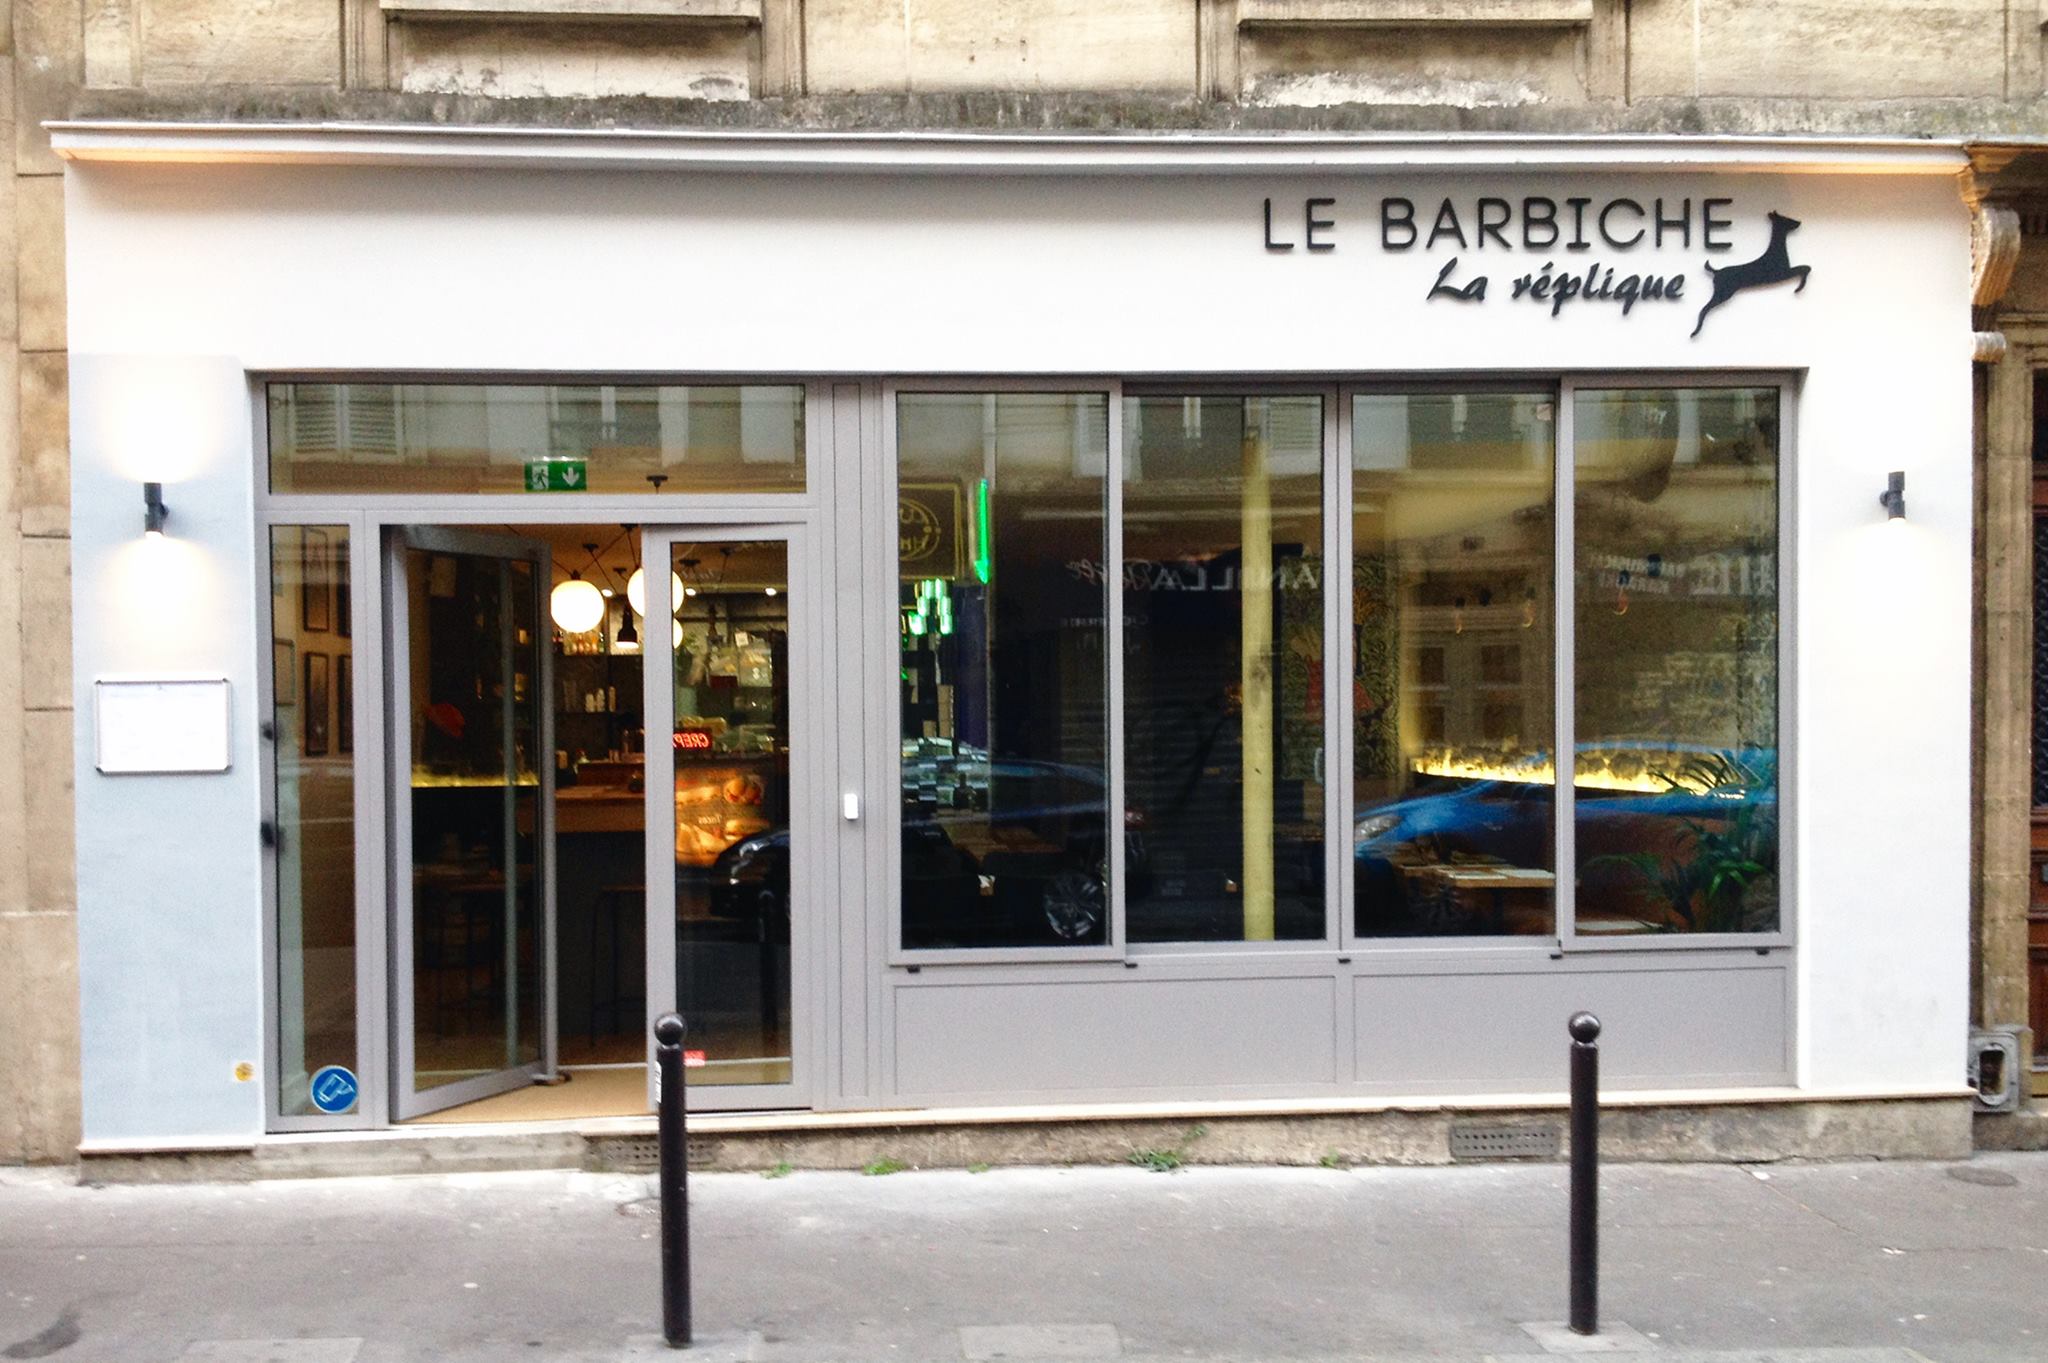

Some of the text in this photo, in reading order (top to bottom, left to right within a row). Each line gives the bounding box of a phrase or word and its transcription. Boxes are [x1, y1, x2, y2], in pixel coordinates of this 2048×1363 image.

[1264, 197, 1734, 251] LE BARBICHE
[1426, 257, 1686, 317] La réplique
